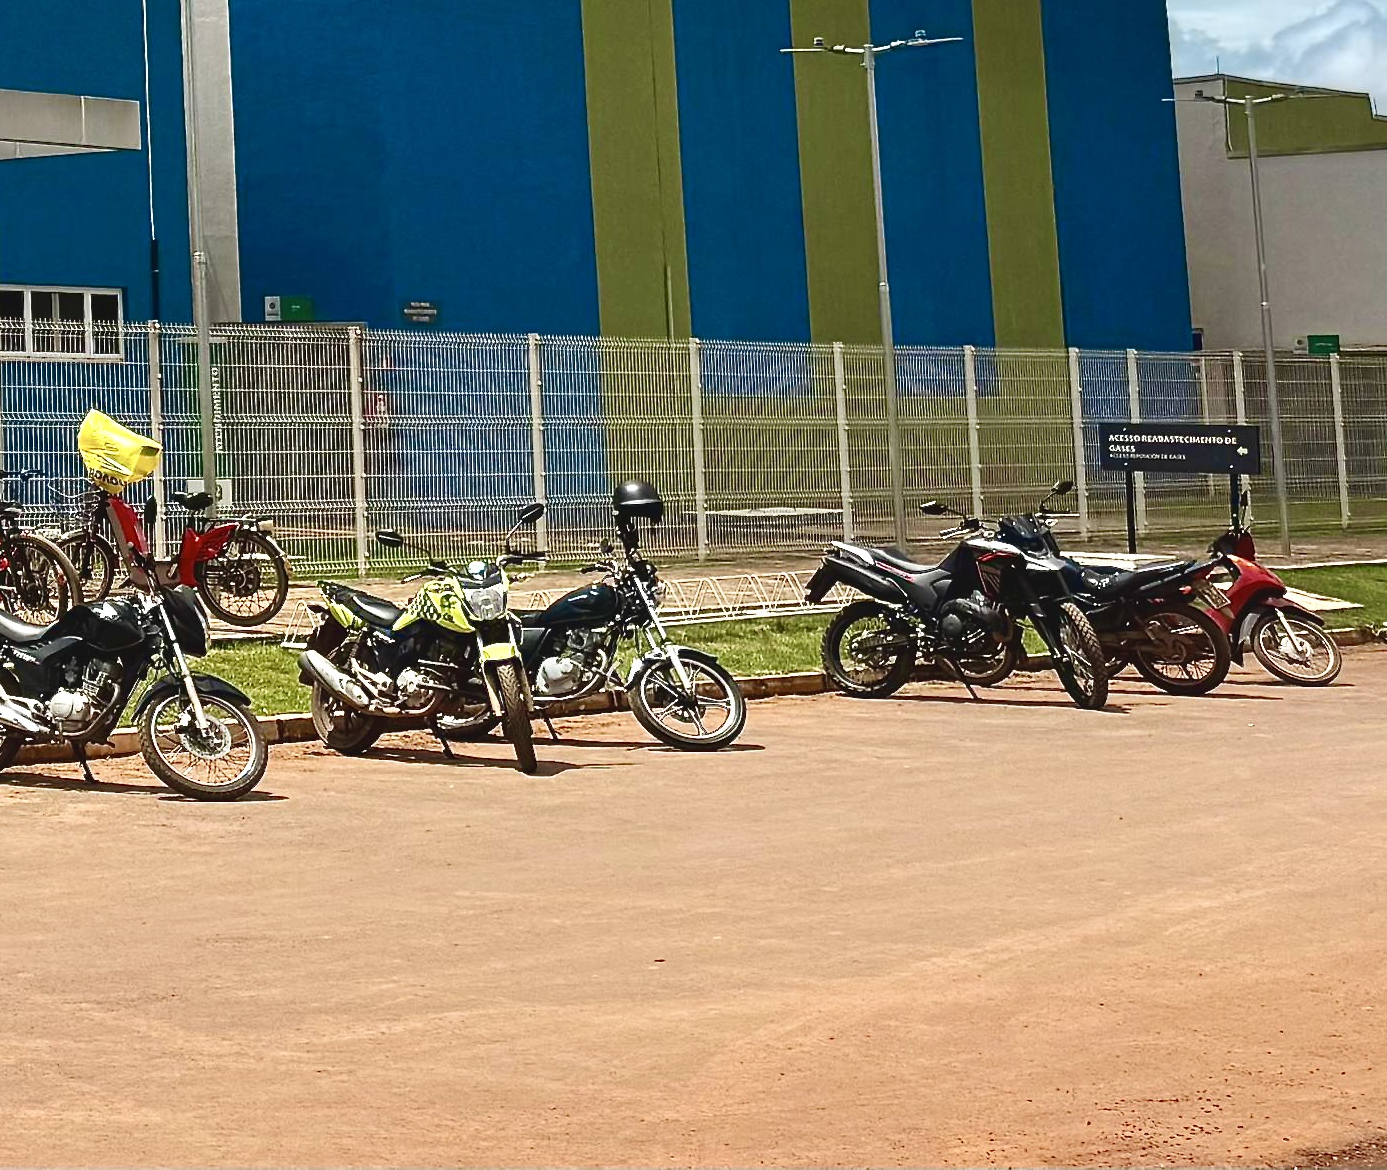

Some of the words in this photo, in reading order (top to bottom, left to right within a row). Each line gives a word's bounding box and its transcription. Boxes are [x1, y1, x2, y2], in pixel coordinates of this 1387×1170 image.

[1108, 434, 1141, 442] ACESSO
[1224, 436, 1237, 445] DE
[1108, 445, 1136, 453] GASES
